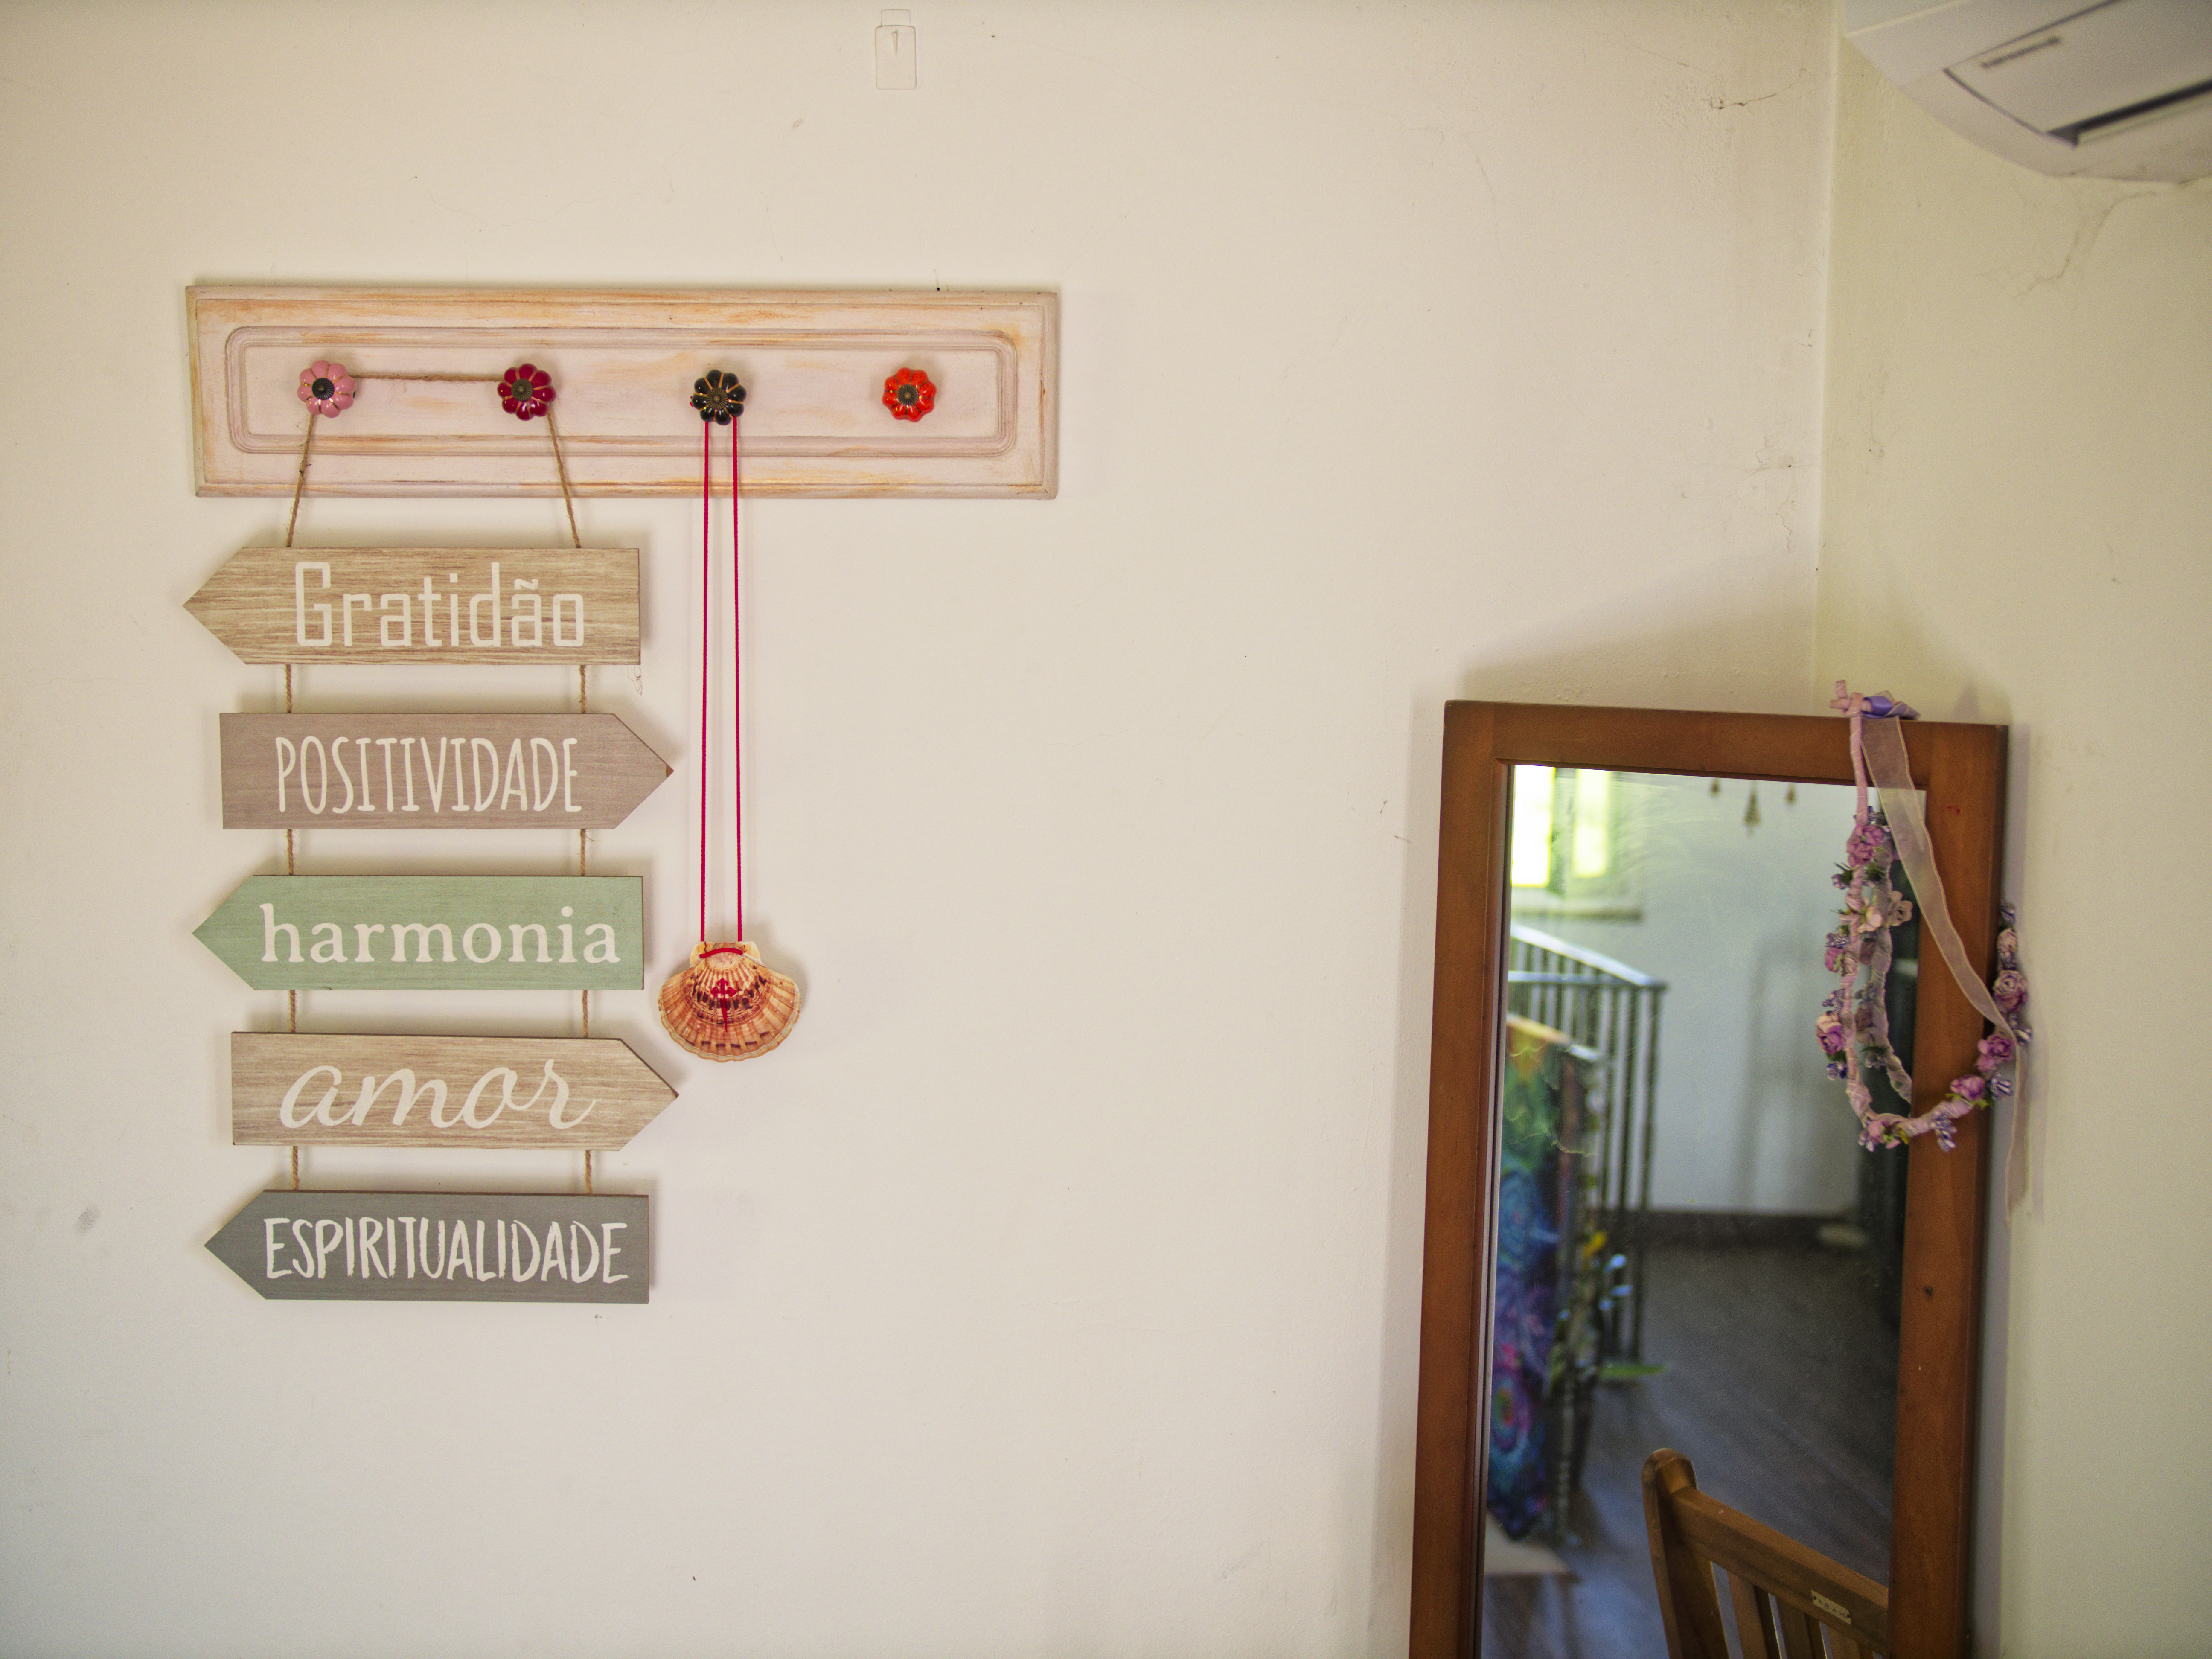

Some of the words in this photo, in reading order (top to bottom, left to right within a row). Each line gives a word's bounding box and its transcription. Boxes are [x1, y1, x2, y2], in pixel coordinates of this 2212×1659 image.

[295, 561, 585, 648] Gratidão
[276, 736, 582, 814] POSITIVIDADE
[260, 903, 621, 963] harmonia
[280, 1059, 595, 1129] amor
[265, 1217, 628, 1283] ESPIRITUALIDADE
